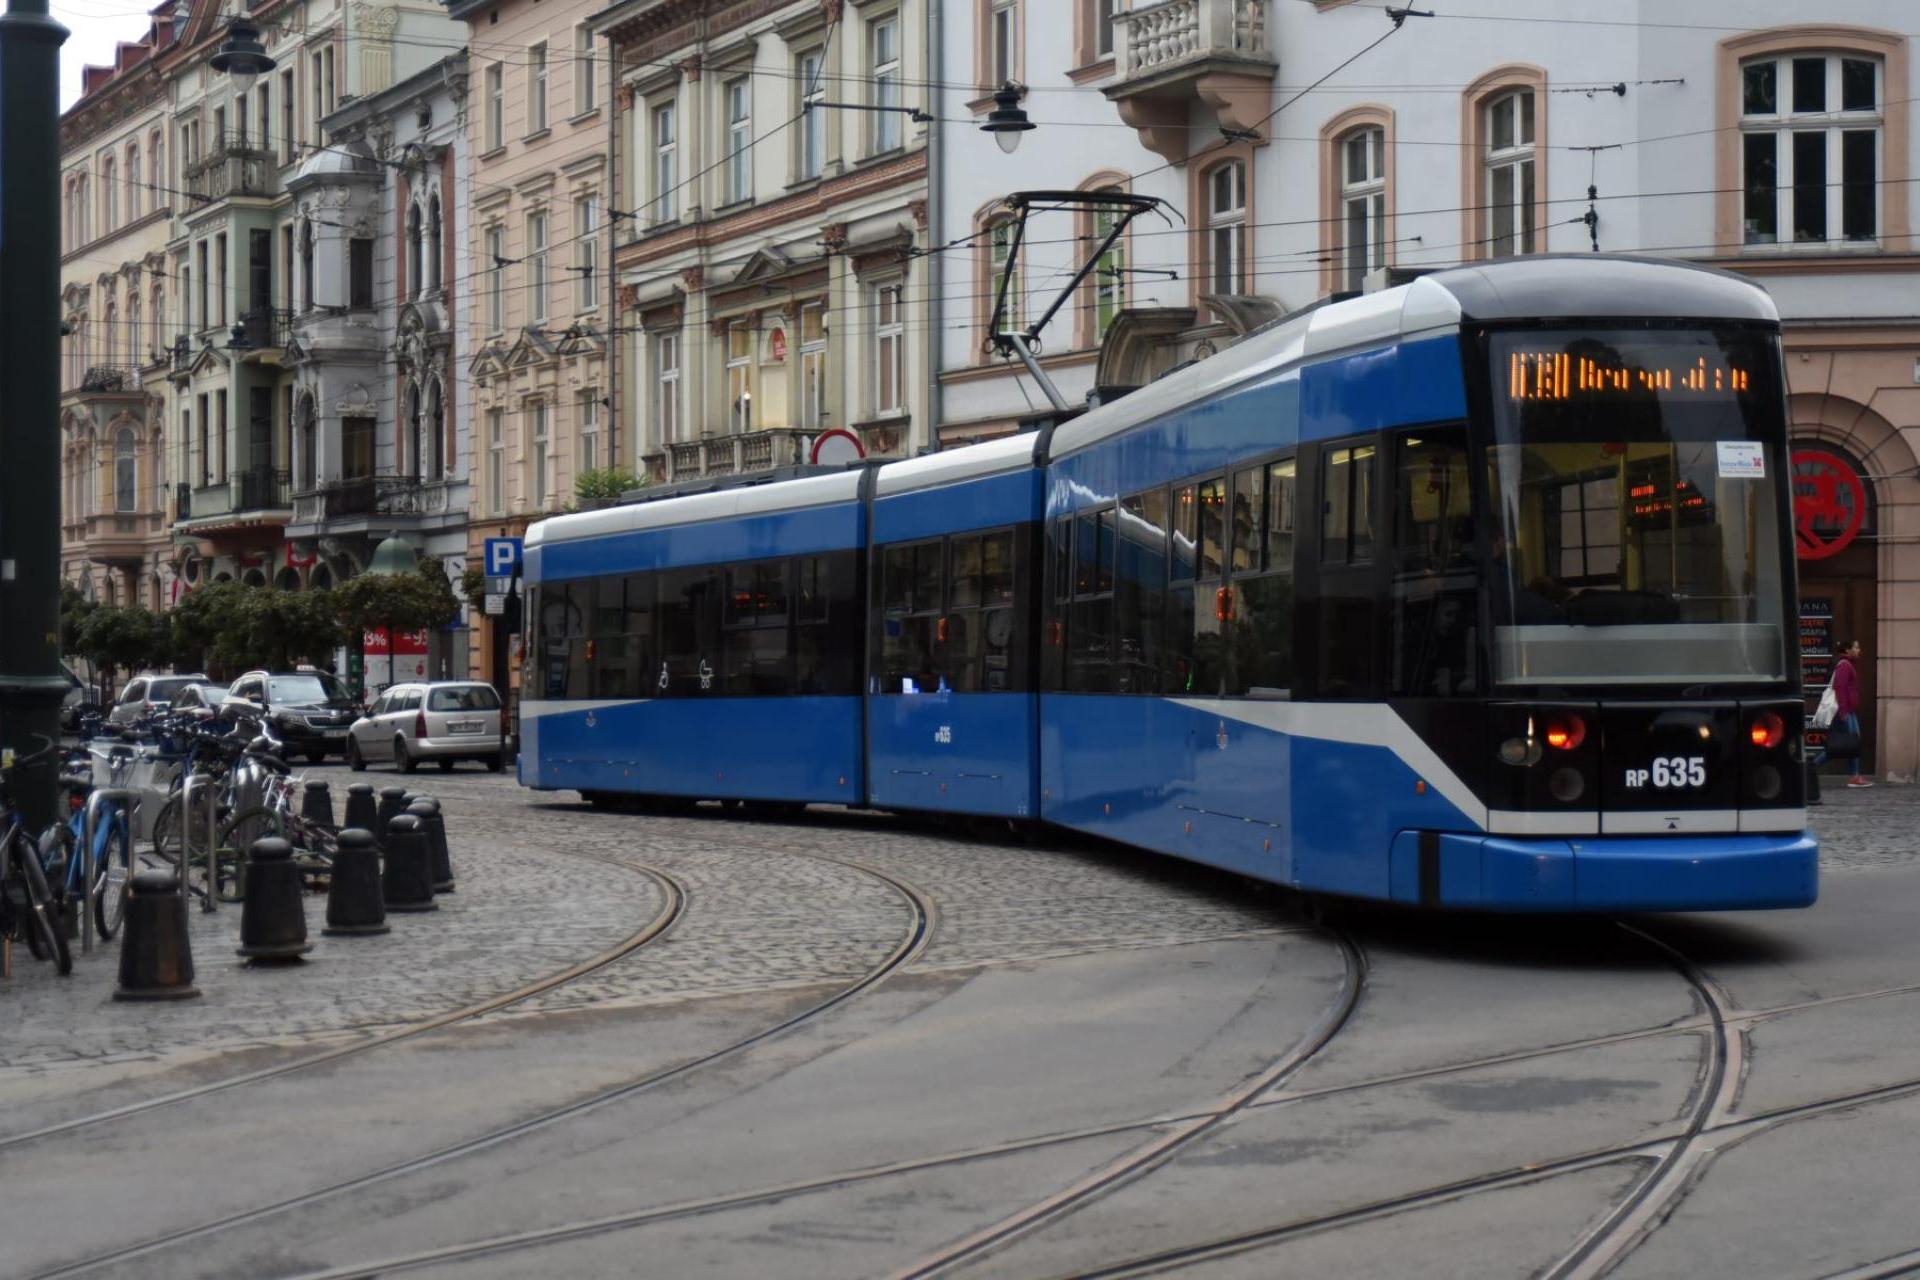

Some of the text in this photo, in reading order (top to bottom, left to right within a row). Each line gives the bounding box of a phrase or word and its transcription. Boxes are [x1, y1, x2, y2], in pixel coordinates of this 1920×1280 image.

[492, 542, 515, 573] P
[940, 725, 951, 743] 635
[1625, 757, 1706, 787] RP 635
